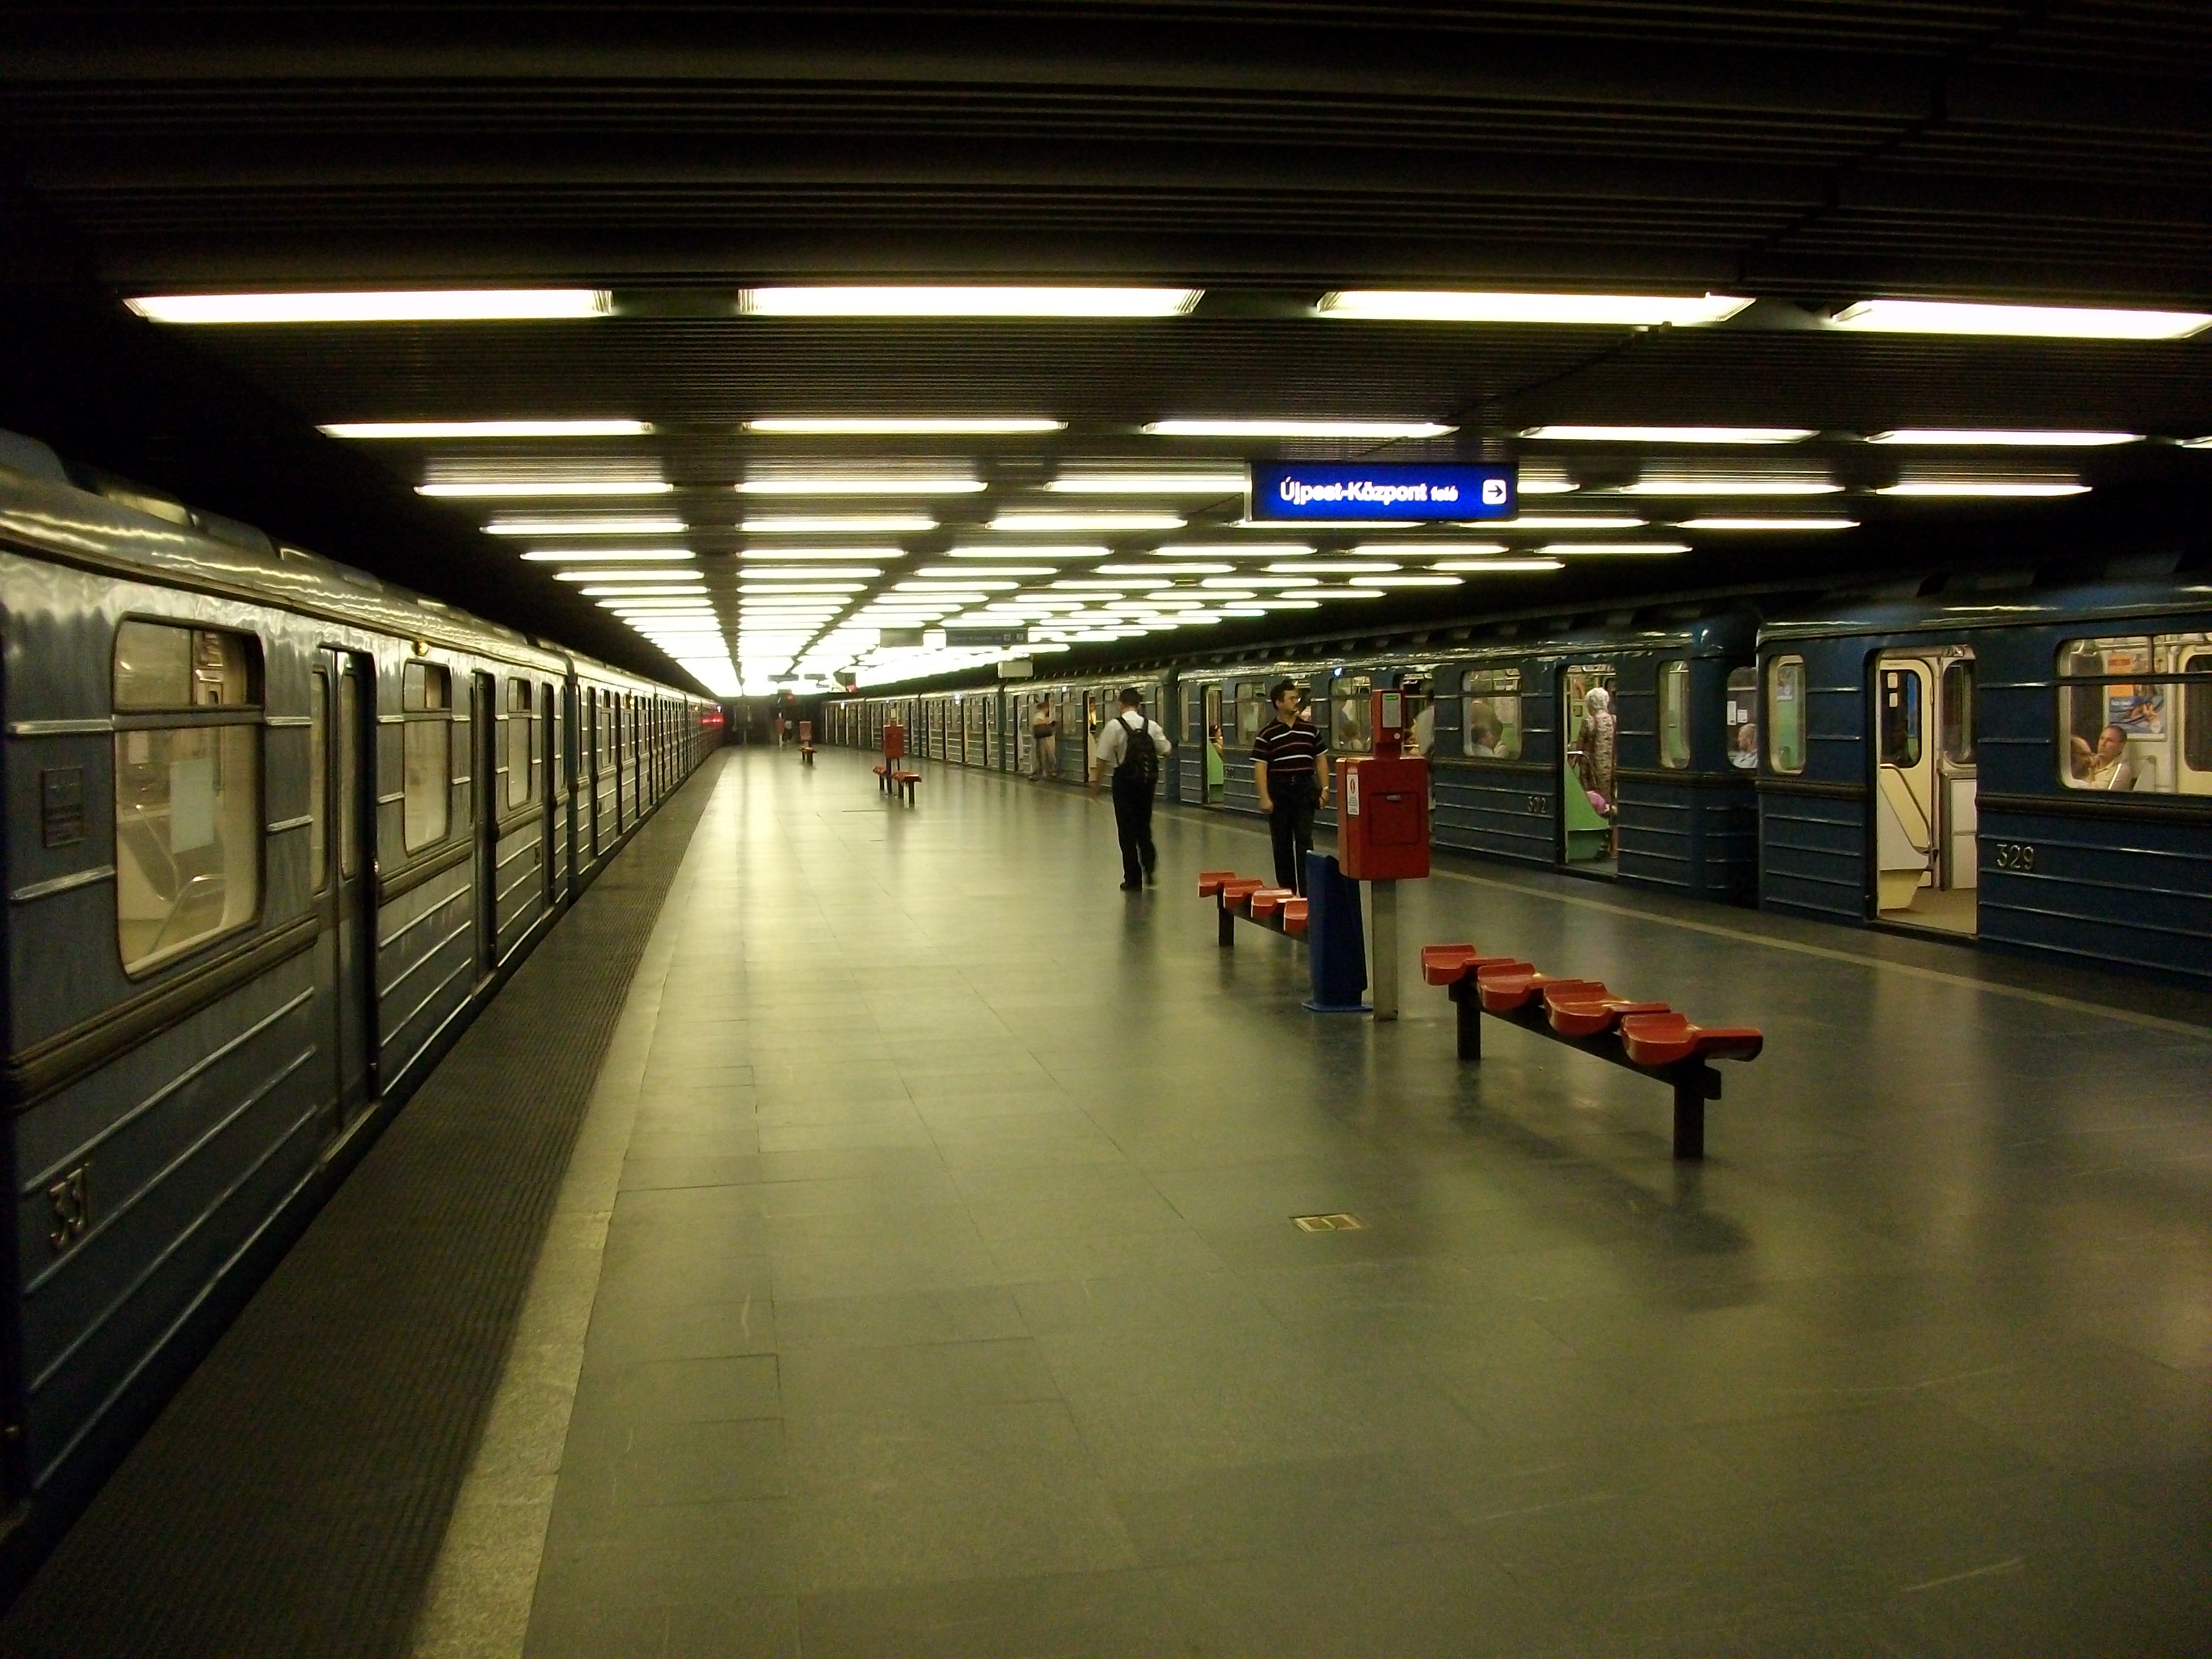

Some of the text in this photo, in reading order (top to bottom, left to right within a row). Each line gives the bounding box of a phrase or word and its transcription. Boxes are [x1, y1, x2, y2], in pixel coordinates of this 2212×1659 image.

[1281, 476, 1427, 506] Újpest-Központ
[1527, 796, 1546, 814] 302
[1996, 843, 2034, 871] 329
